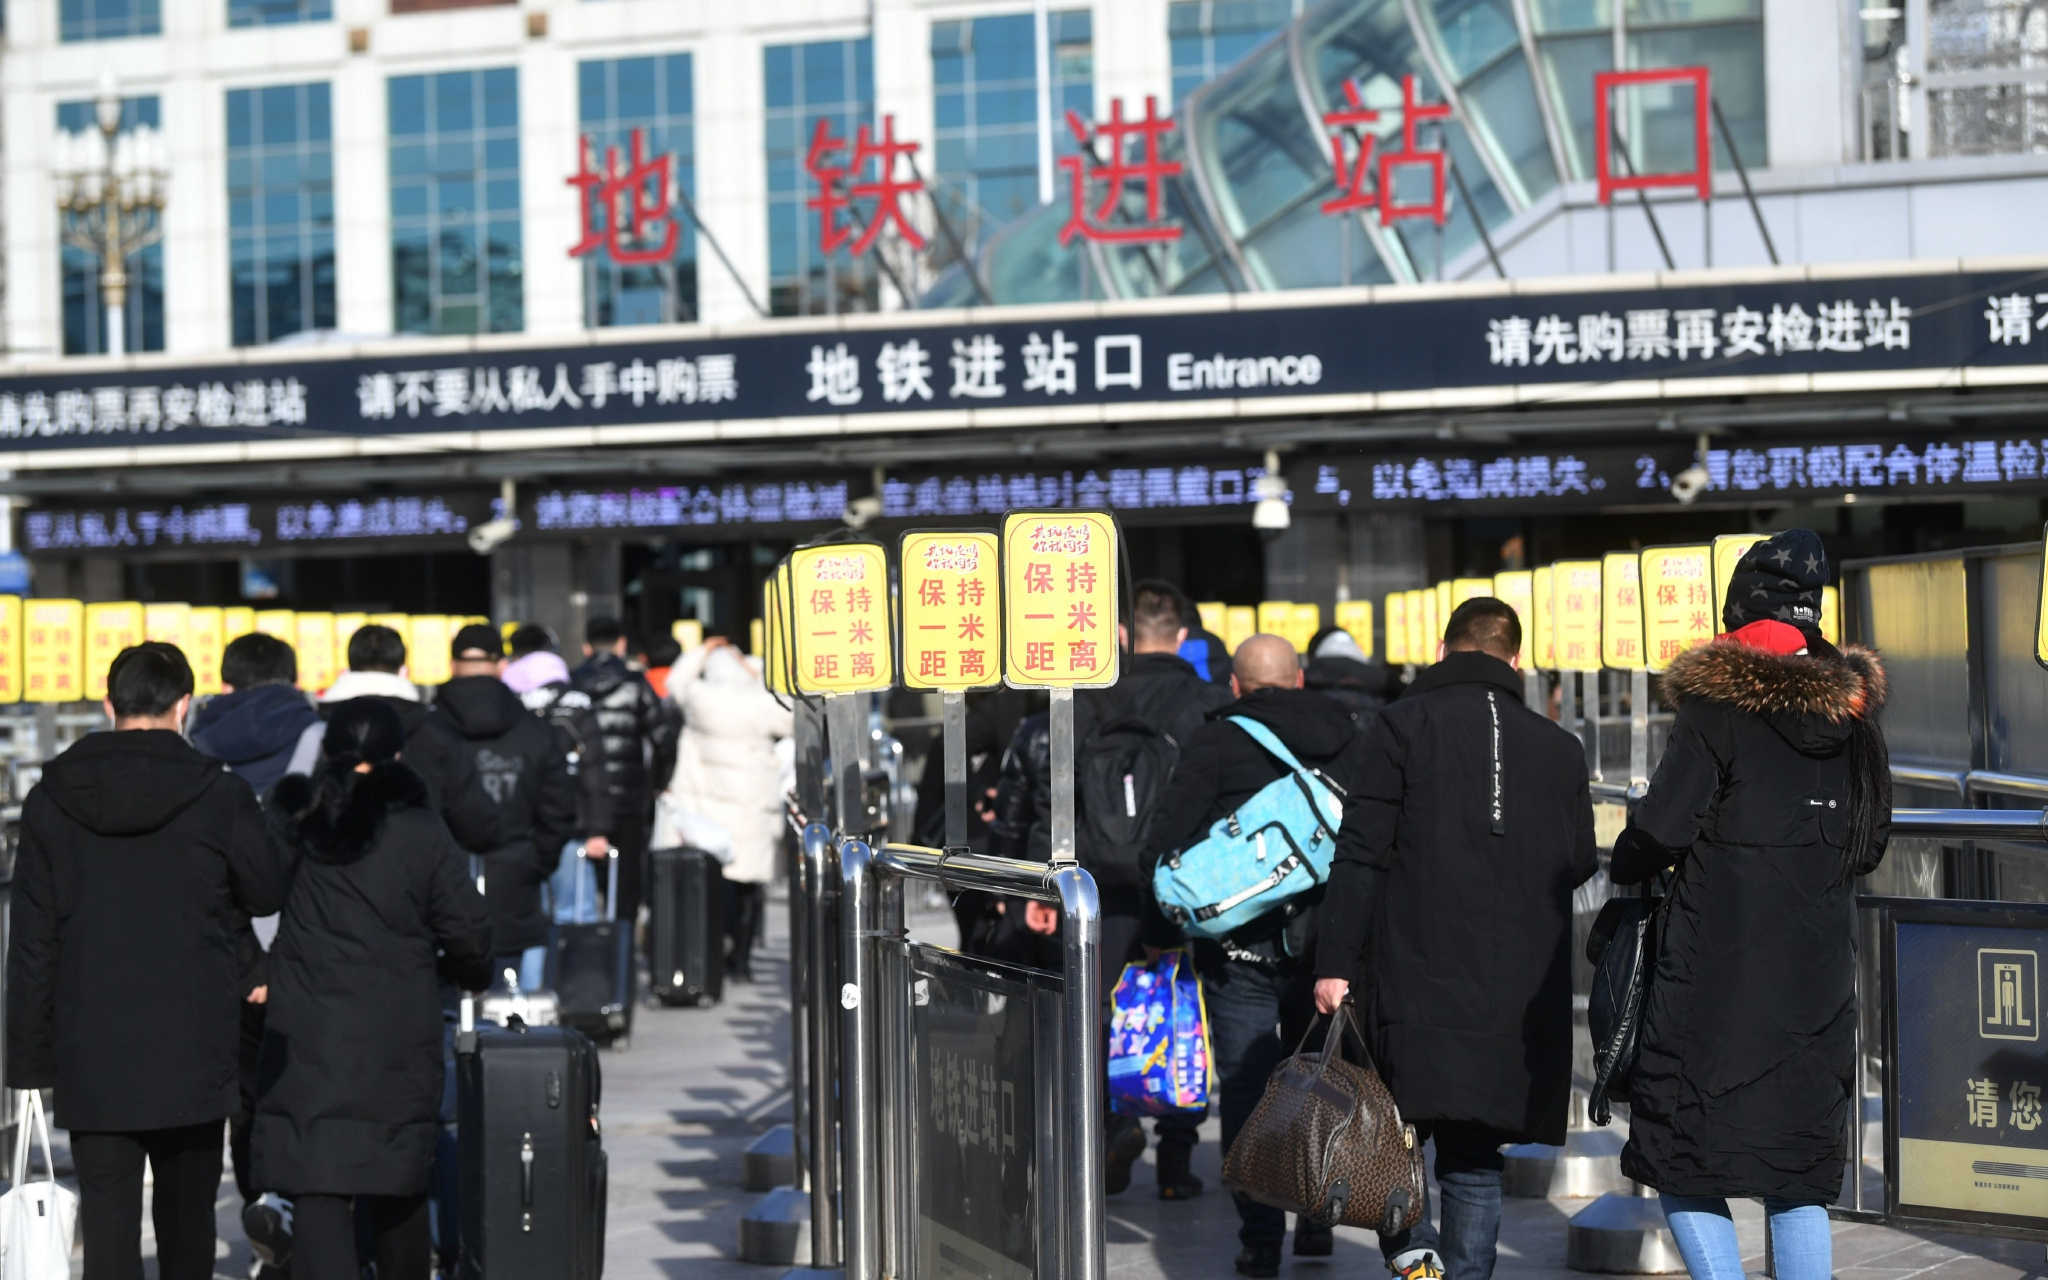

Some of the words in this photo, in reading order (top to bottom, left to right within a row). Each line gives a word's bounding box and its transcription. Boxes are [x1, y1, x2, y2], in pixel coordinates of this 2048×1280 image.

[567, 65, 1710, 264] 地铁进站口
[1487, 297, 1911, 367] 请先购票再安检进站
[357, 354, 738, 419] 请不要从私人手中购票
[805, 330, 1143, 405] 地铁进站口
[1167, 351, 1322, 391] Entrance
[1030, 523, 1090, 541] 共抗疫情
[1032, 540, 1089, 557] 你我同行
[918, 578, 985, 607] 保持
[1024, 562, 1097, 594] 保持
[810, 587, 872, 614] 保持
[1656, 583, 1709, 606] 保持
[919, 613, 985, 642] 一米
[1024, 601, 1097, 632] 一米
[1658, 610, 1710, 632] 一米
[812, 620, 874, 645] 一米
[813, 652, 875, 679] 距离
[919, 648, 985, 678] 距离
[1024, 640, 1097, 672] 距离
[1966, 1077, 2043, 1132] 请您
